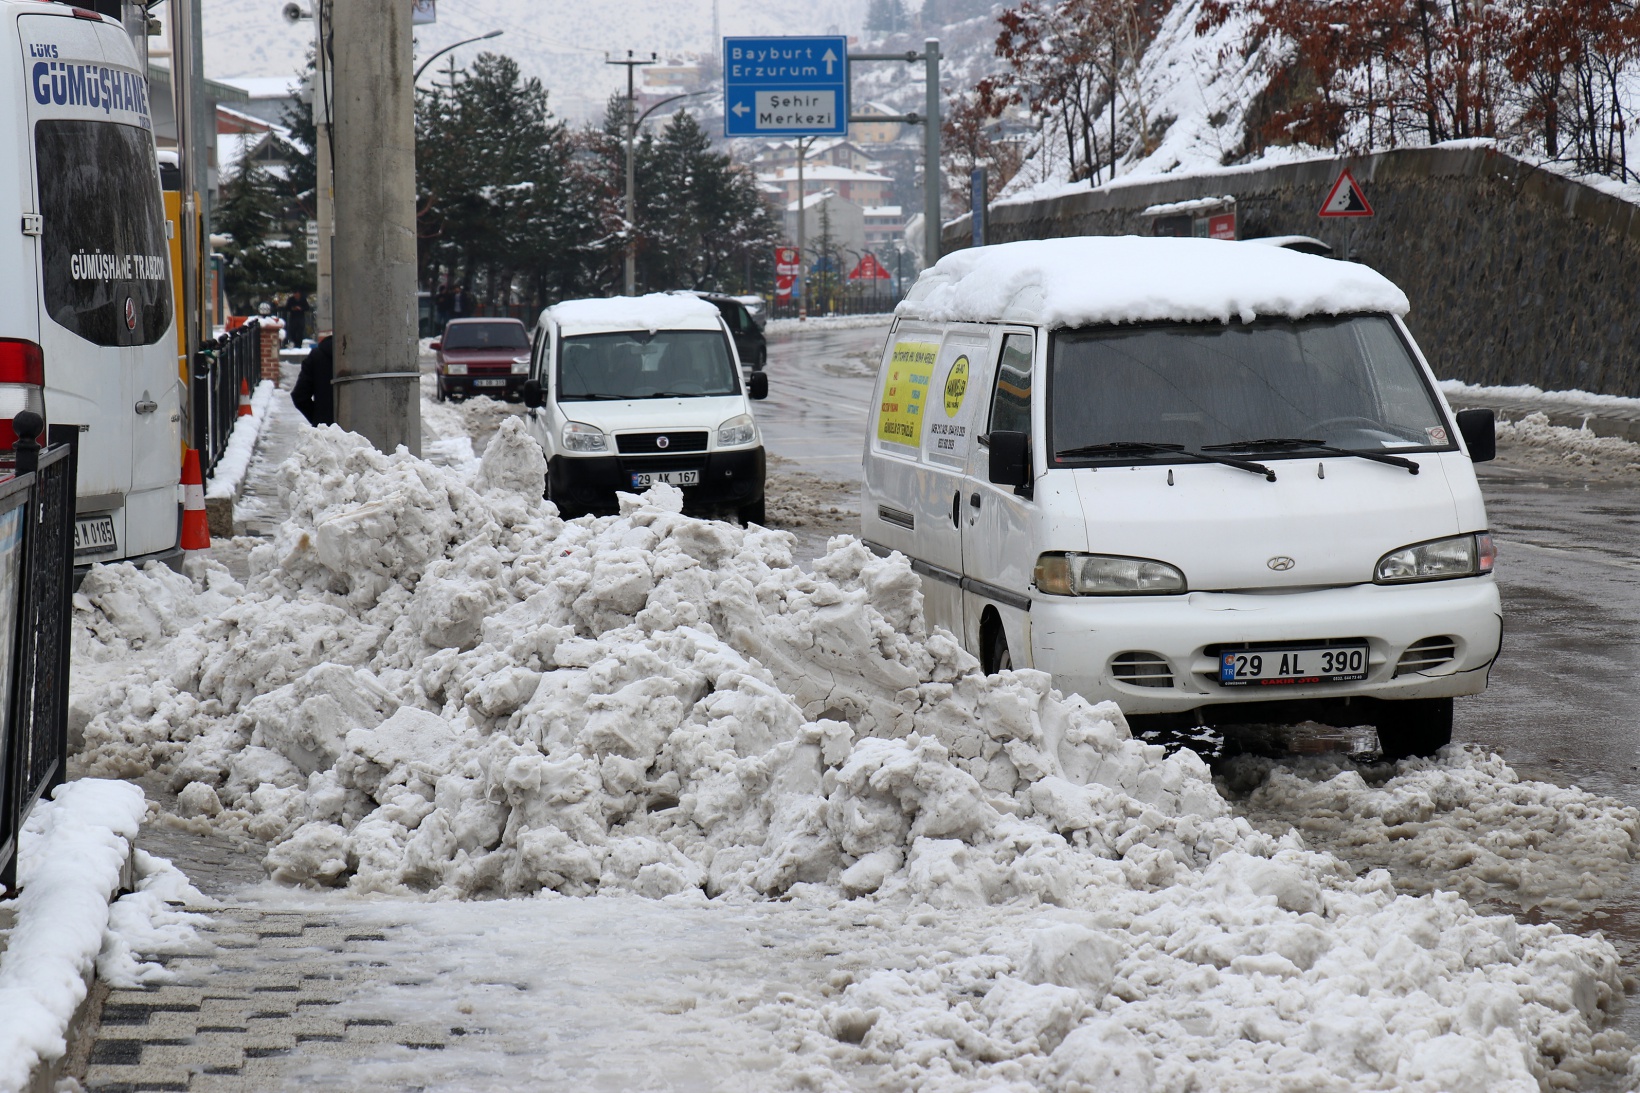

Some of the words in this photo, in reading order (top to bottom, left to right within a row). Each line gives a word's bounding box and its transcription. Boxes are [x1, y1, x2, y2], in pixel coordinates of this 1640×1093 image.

[30, 44, 58, 58] LÜKS
[732, 47, 813, 62] Bayburt
[732, 65, 818, 77] Erzurum
[33, 62, 148, 115] GÜMÜŞHANE
[770, 95, 819, 108] Şehir
[760, 113, 831, 124] Merkezi
[71, 249, 132, 283] GÜMÜŞHANE
[133, 255, 165, 280] TRABZON
[638, 475, 651, 484] 29
[659, 473, 670, 483] AK
[679, 472, 696, 482] 167
[81, 523, 89, 545] M
[90, 521, 113, 544] 0185
[1224, 668, 1234, 676] TR
[1235, 655, 1262, 677] 29
[1279, 653, 1304, 675] AL
[1321, 650, 1362, 673] 390
